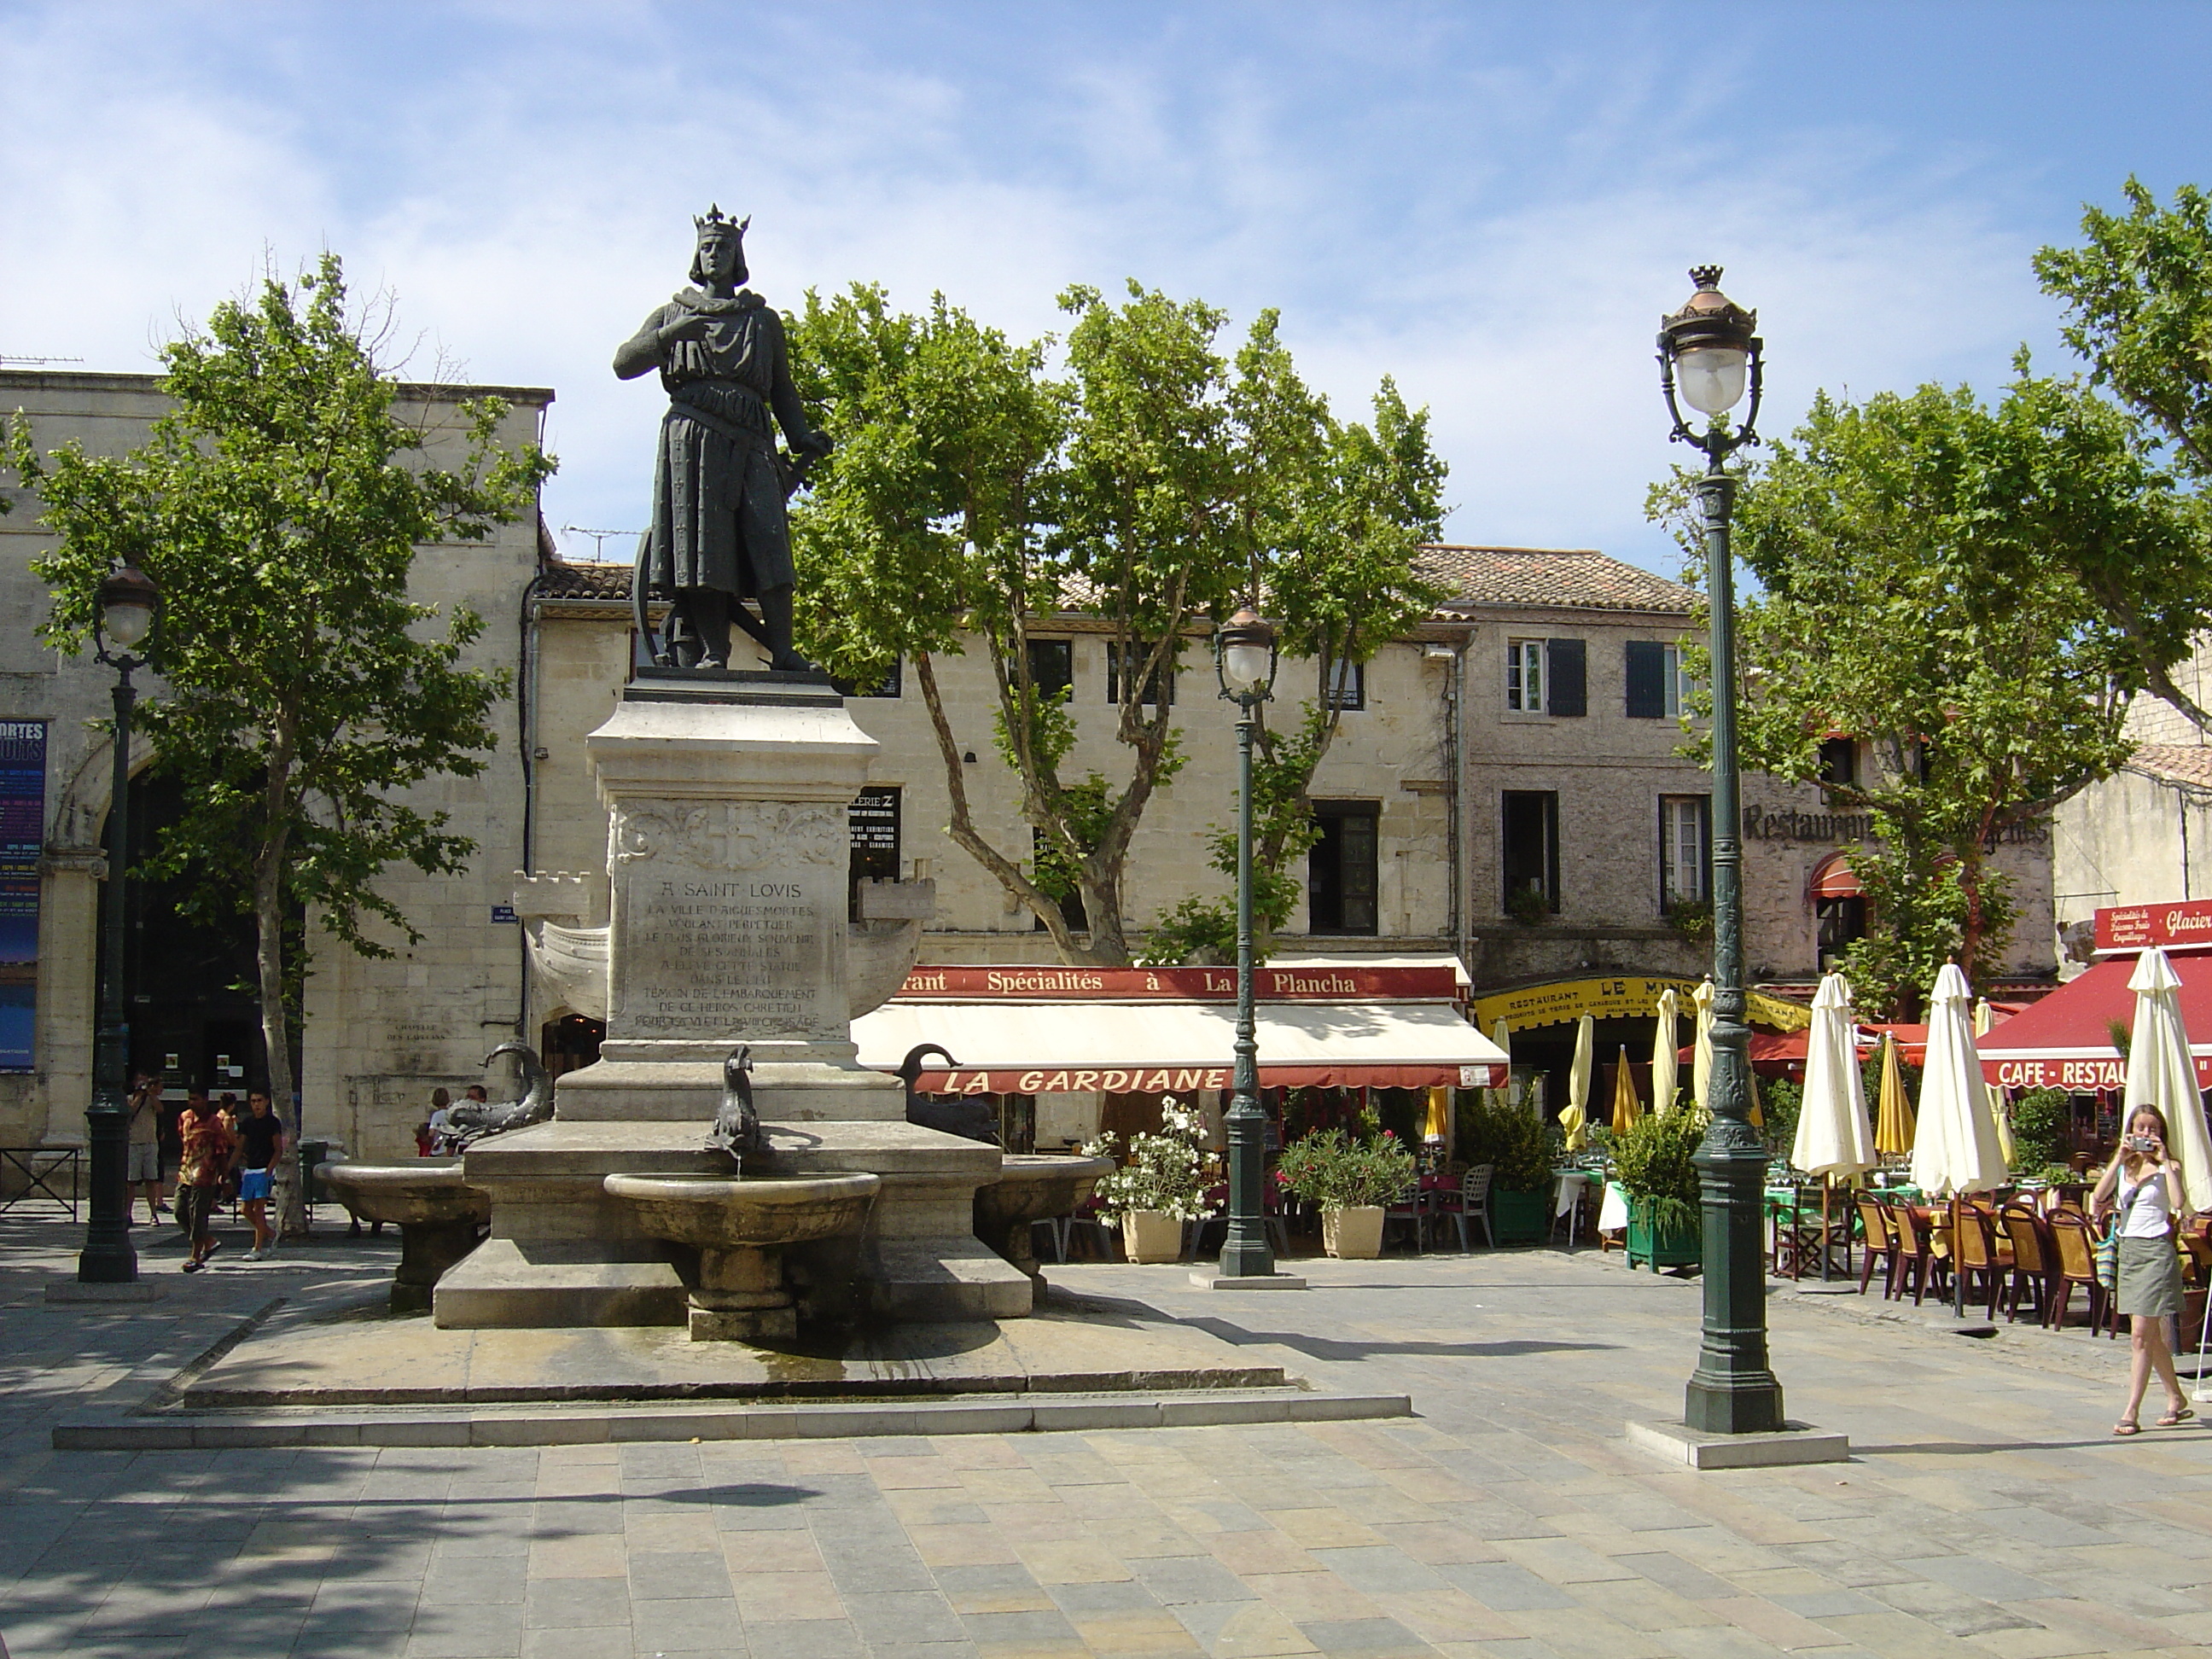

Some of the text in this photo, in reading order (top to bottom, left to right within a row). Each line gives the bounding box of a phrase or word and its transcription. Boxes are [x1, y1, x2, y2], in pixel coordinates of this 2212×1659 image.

[684, 882, 740, 897] SAINT
[649, 905, 664, 914] LA
[671, 905, 703, 915] VILLE
[646, 933, 659, 943] LE
[680, 946, 694, 956] DE
[728, 975, 741, 985] LE
[987, 971, 1103, 994] Spécialités
[1146, 972, 1161, 992] à
[1204, 973, 1233, 992] La
[1273, 974, 1357, 994] Plancha
[1601, 981, 1627, 996] LE
[1509, 992, 1579, 1010] RESTAURANT
[943, 1068, 1227, 1093] LA GARDIANE
[1999, 1062, 2128, 1085] CAFE RESTAU
